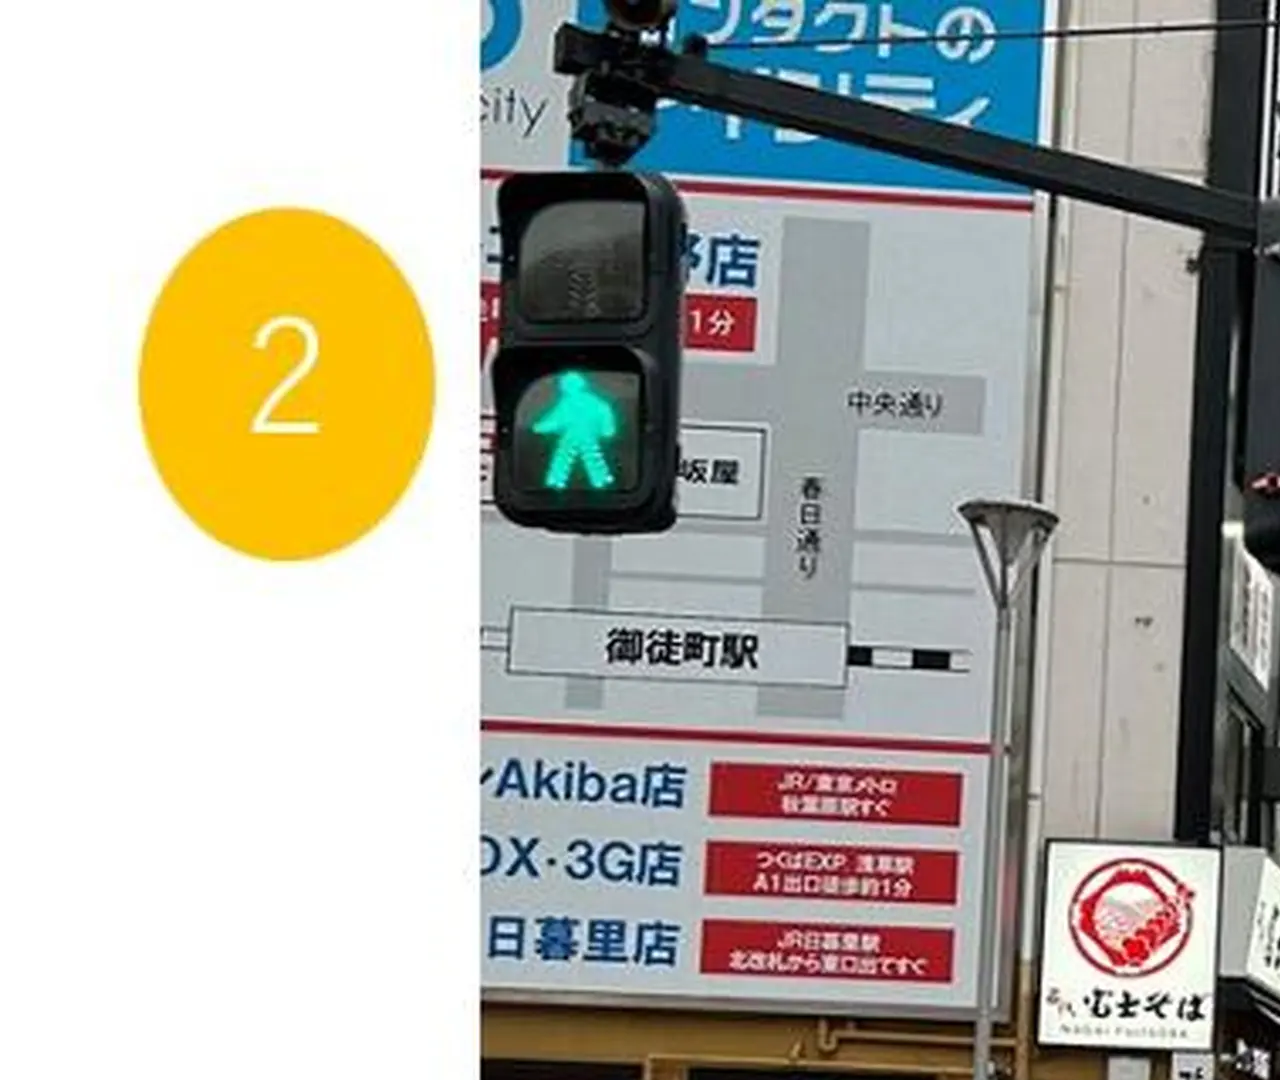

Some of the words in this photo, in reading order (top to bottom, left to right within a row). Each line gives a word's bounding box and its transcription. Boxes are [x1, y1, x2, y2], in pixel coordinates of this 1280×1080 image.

[664, 0, 997, 63] ンタクトの
[847, 389, 943, 417] 中央通り
[796, 475, 822, 580] 春日通り
[605, 626, 760, 670] 御徒町駅
[487, 914, 682, 967] 日暮里店
